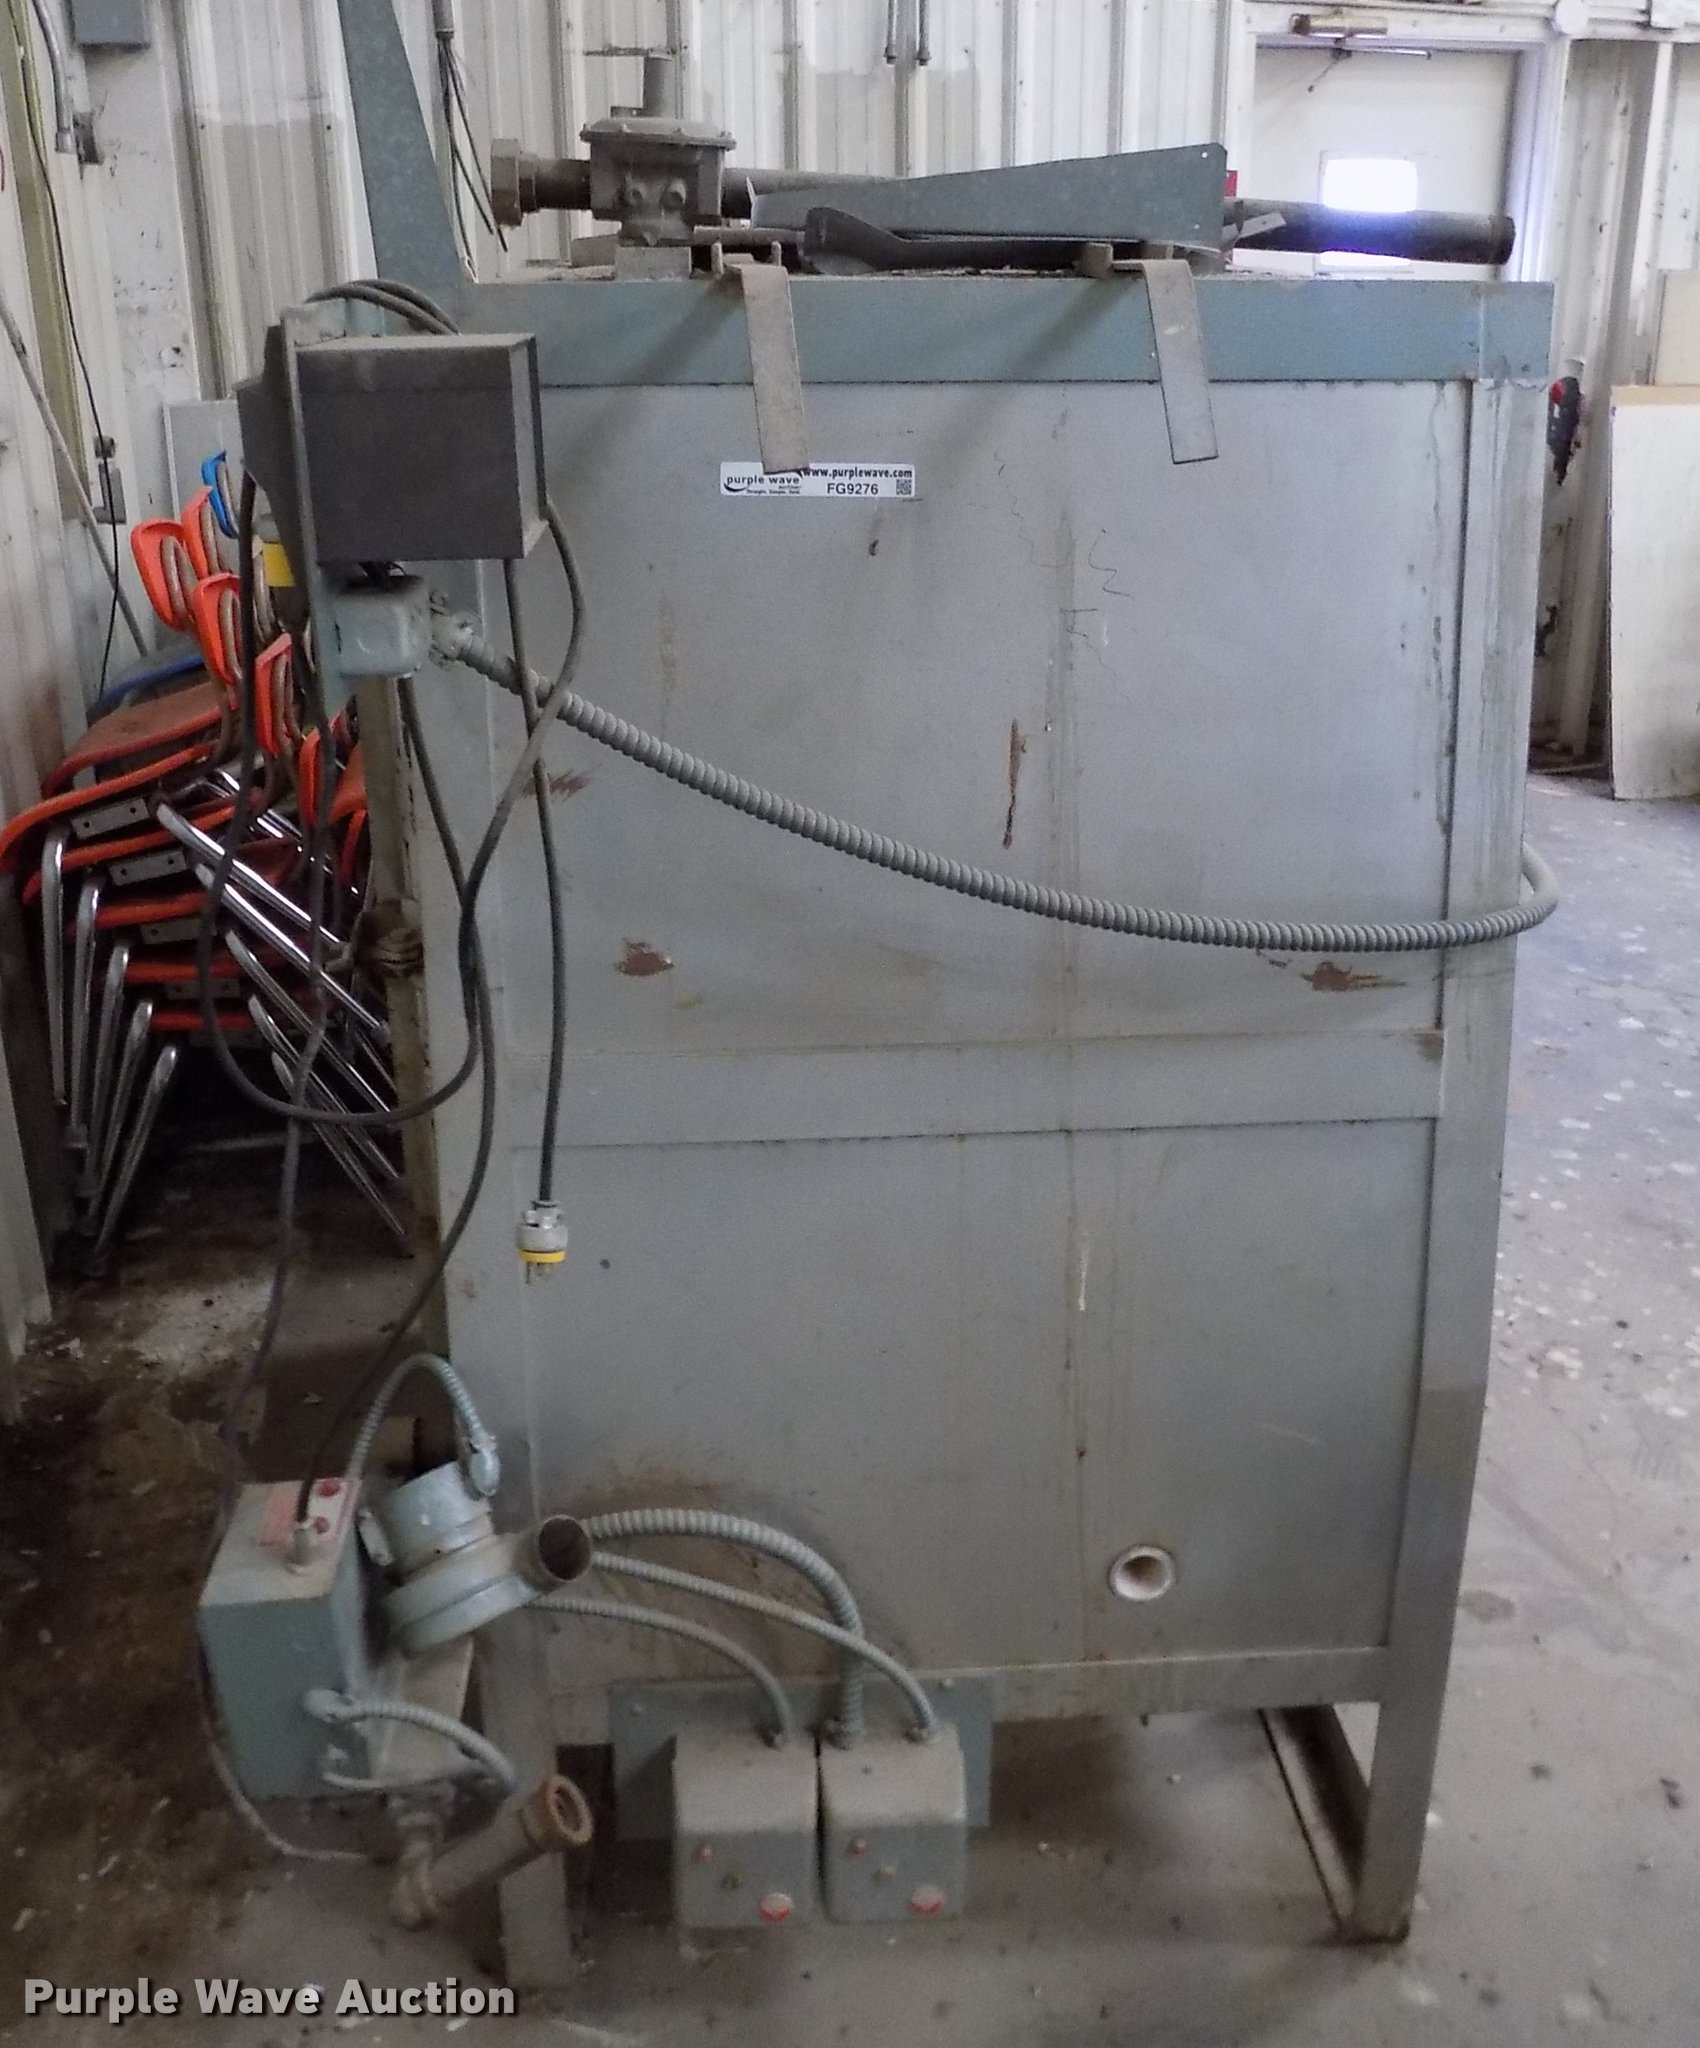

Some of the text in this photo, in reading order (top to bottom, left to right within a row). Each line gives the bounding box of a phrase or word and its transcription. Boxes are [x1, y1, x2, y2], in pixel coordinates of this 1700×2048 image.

[802, 466, 913, 481] www.purplewave.com
[726, 475, 800, 486] purple wave
[826, 482, 879, 495] FG9276
